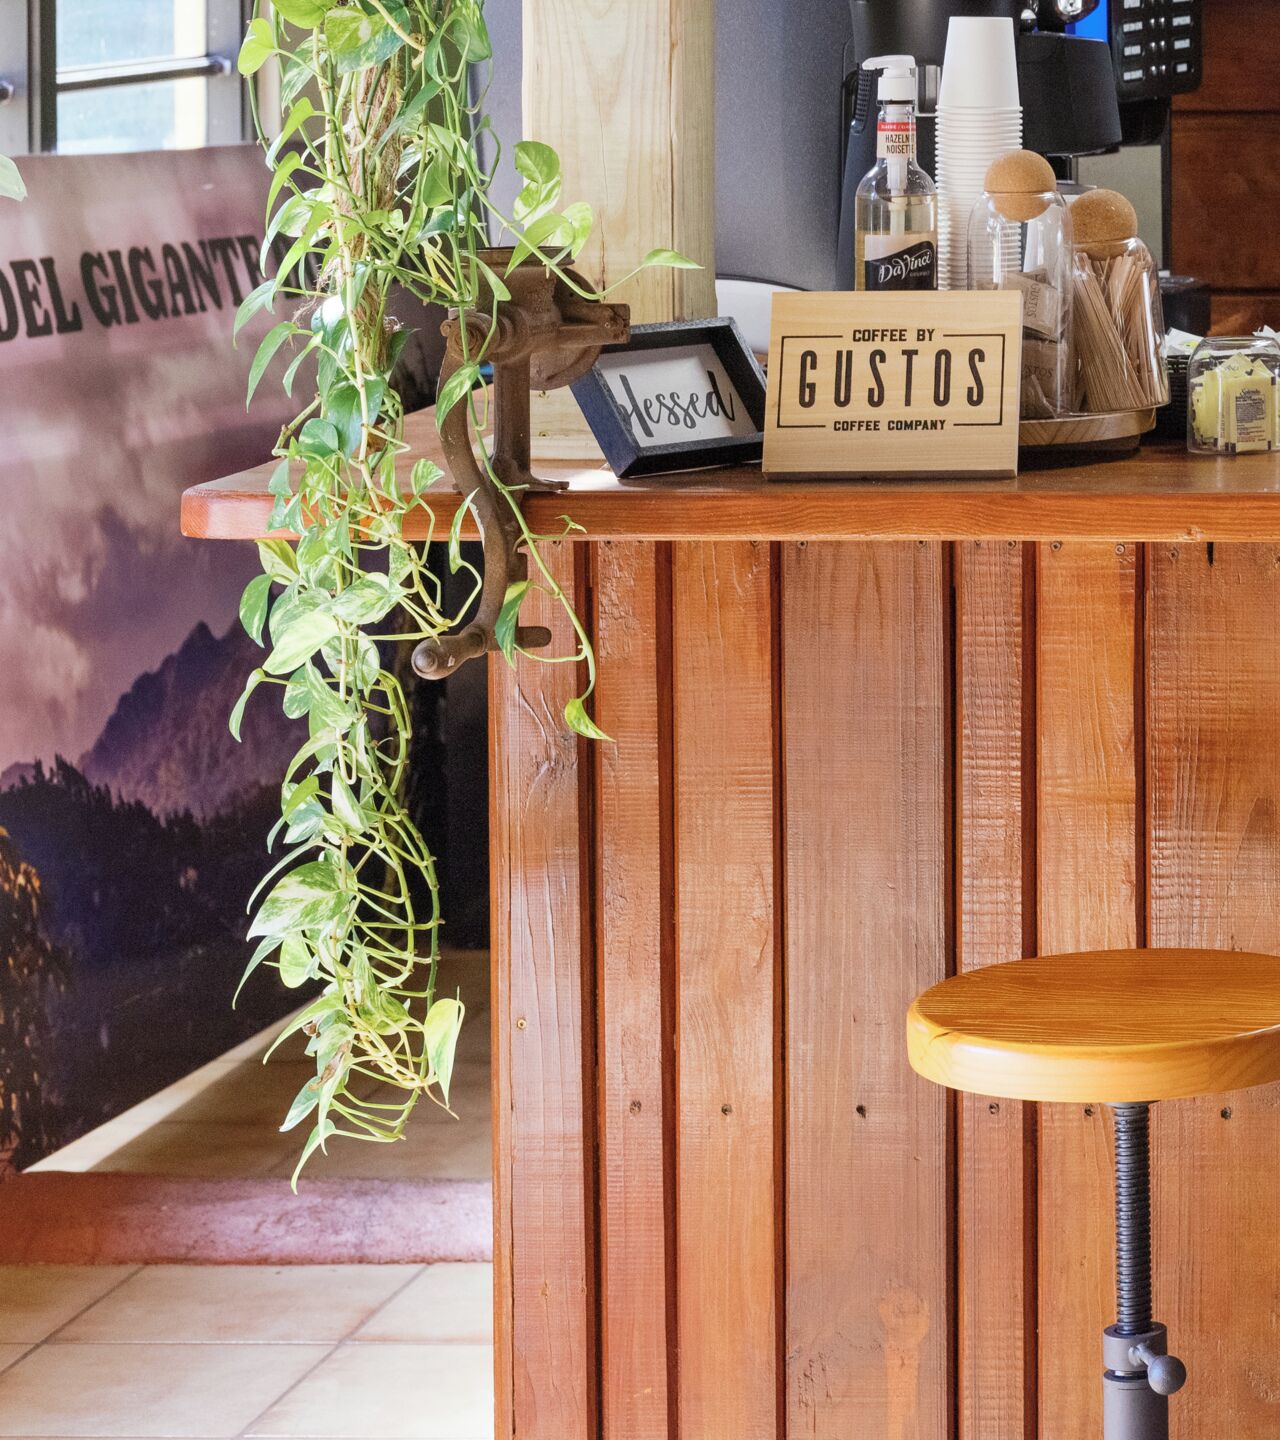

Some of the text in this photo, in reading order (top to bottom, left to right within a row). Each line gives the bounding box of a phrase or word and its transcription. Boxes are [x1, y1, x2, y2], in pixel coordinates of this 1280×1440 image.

[878, 249, 932, 283] DaVinci
[852, 328, 935, 342] COFFEE BY
[799, 348, 986, 408] GUSTOS
[833, 419, 946, 432] COFFEE COMPANY
